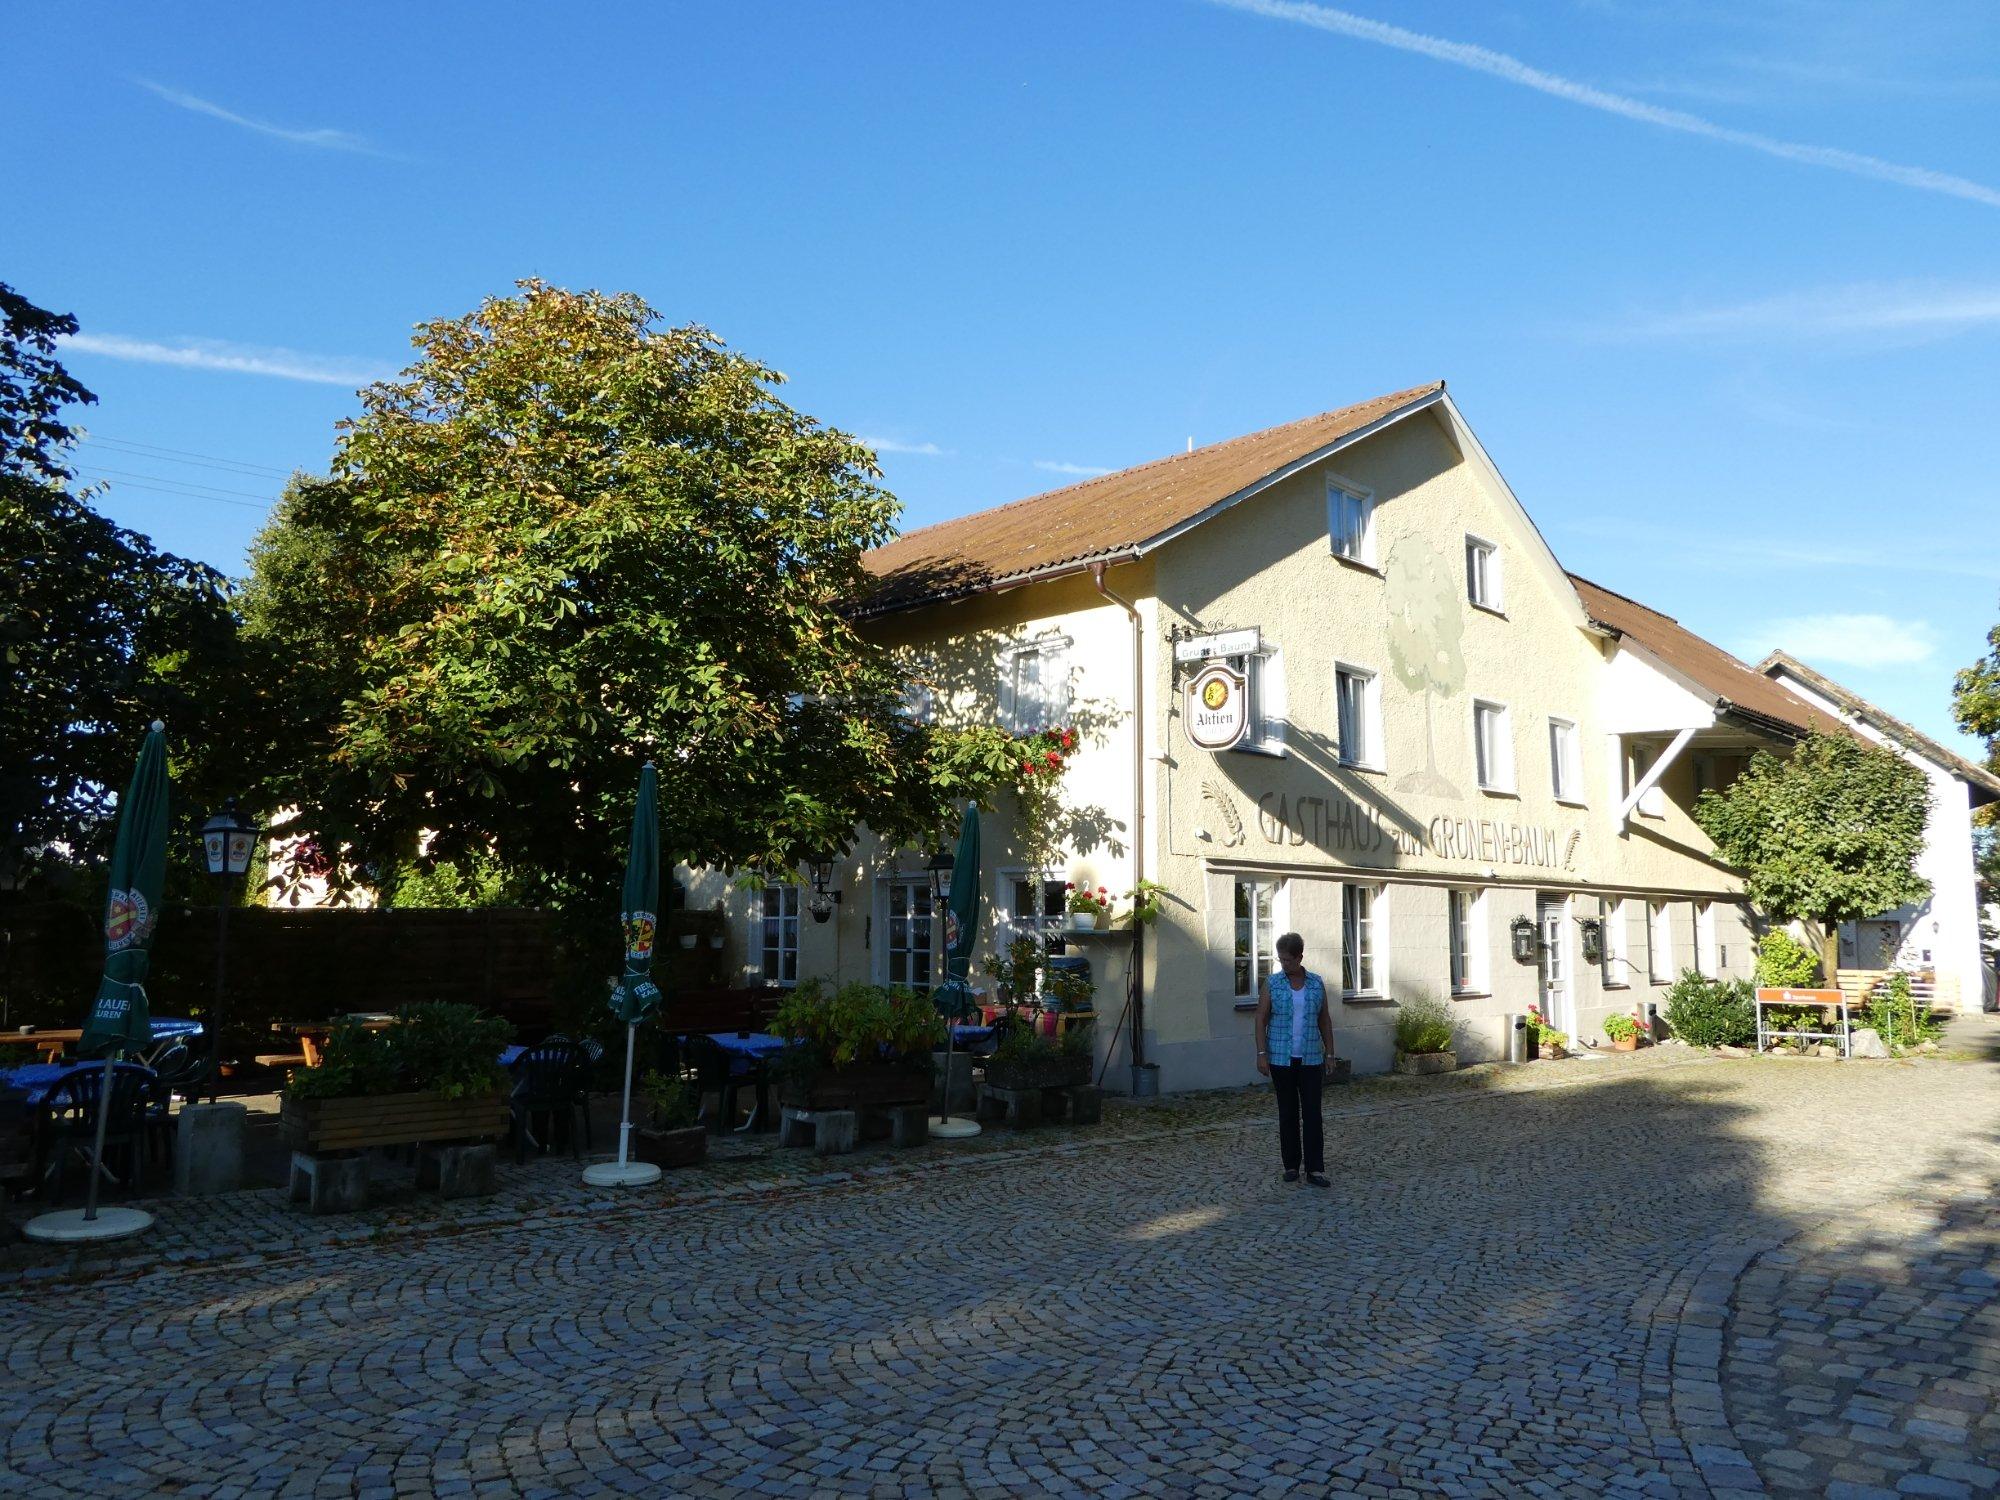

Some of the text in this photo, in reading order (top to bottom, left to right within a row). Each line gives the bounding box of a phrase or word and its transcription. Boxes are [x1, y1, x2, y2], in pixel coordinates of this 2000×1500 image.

[1220, 642, 1251, 653] Baum
[1196, 711, 1233, 726] Aktien
[1257, 791, 1382, 852] GASTHAUS
